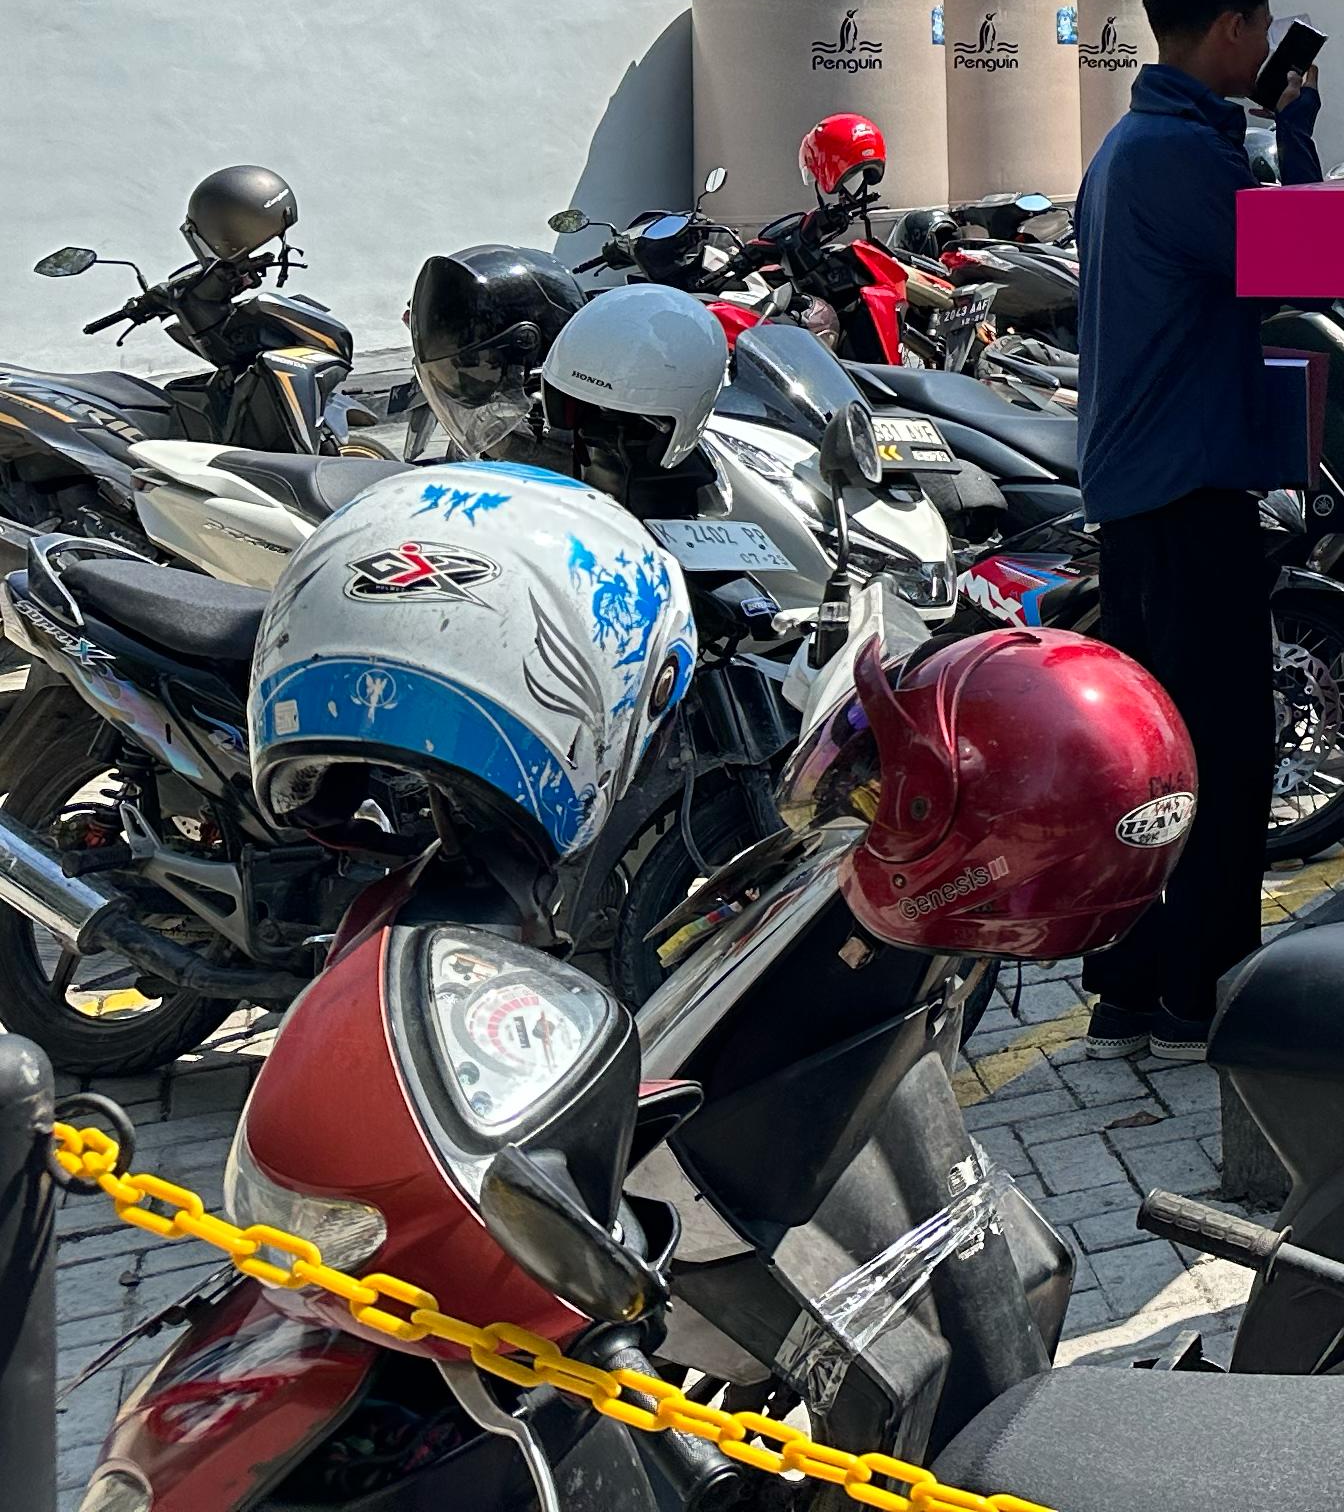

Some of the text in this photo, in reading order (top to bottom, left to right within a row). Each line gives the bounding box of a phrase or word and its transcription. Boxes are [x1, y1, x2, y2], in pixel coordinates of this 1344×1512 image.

[812, 54, 883, 73] Penguin
[953, 55, 1019, 72] Penguin
[1078, 55, 1138, 72] Penguin
[571, 370, 614, 390] HONDA
[653, 525, 678, 544] K
[687, 525, 739, 546] 2402
[898, 865, 991, 920] Genesis
